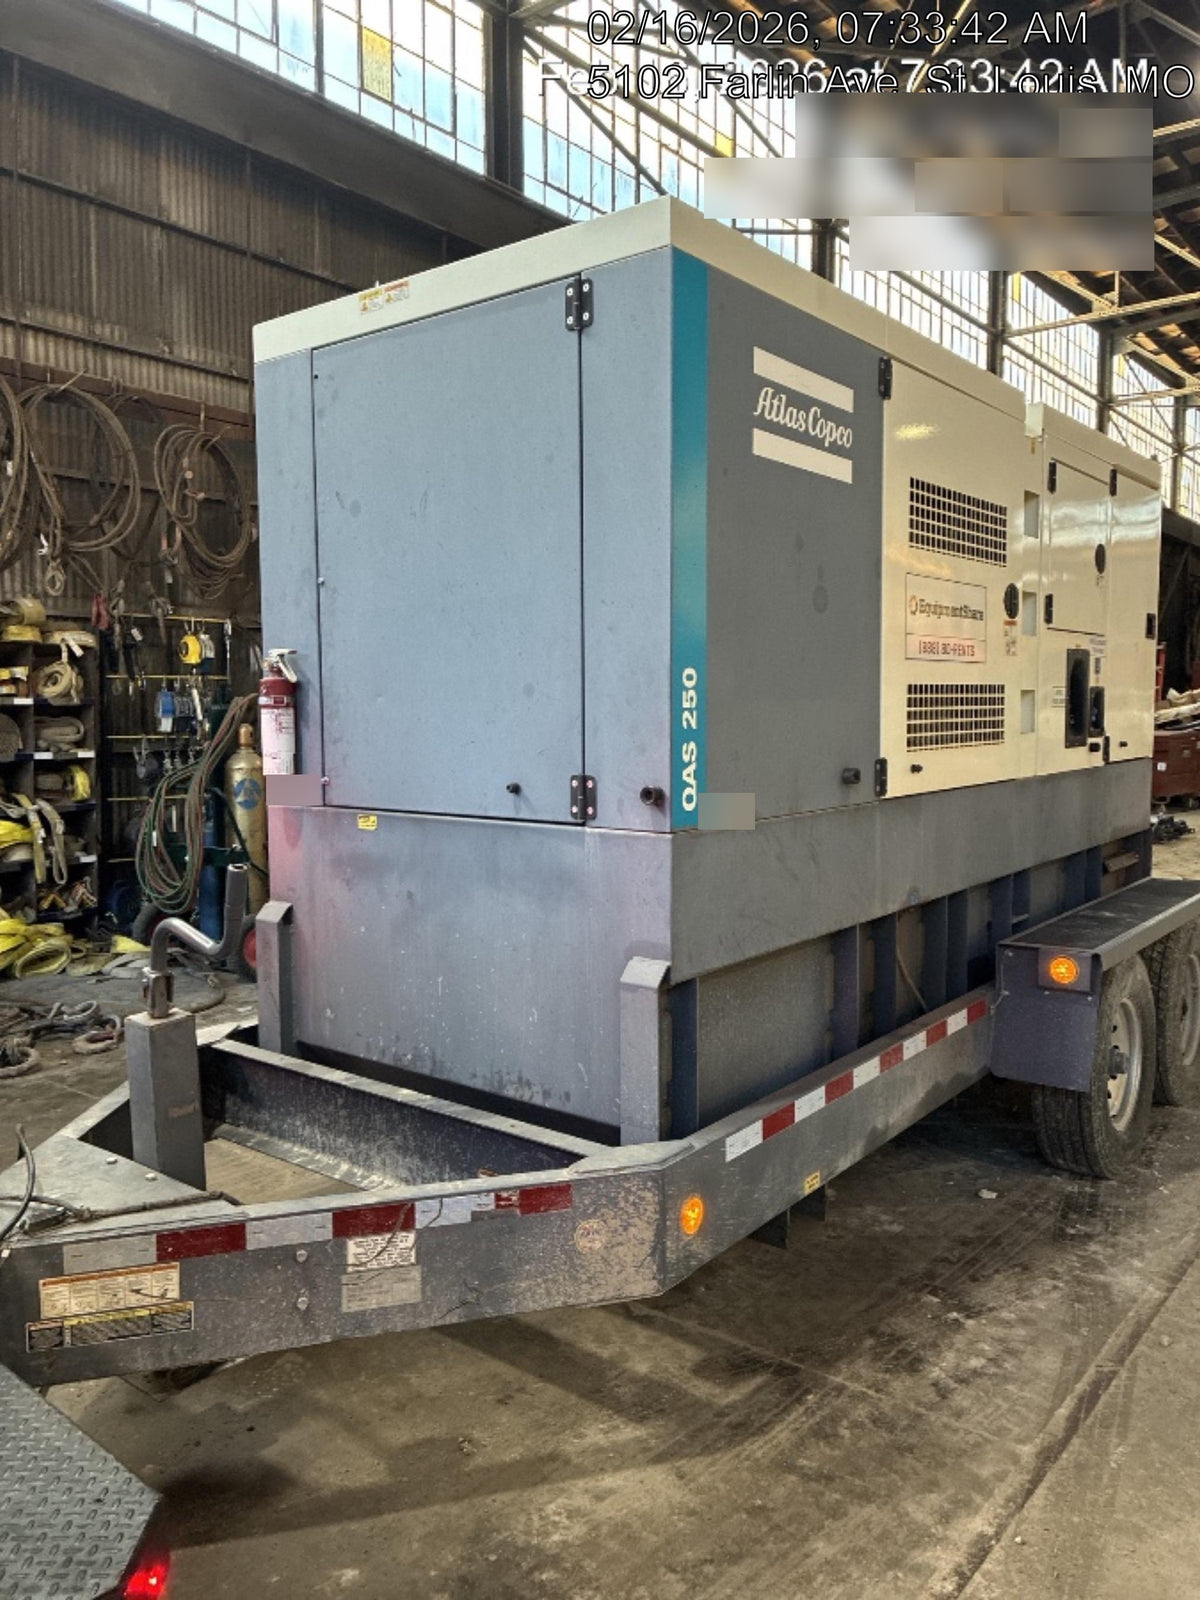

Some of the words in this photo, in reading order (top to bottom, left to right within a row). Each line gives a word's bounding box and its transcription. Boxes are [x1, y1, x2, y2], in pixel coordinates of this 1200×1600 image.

[753, 387, 807, 432] Atlas
[808, 406, 853, 449] Copco
[682, 667, 698, 729] 250
